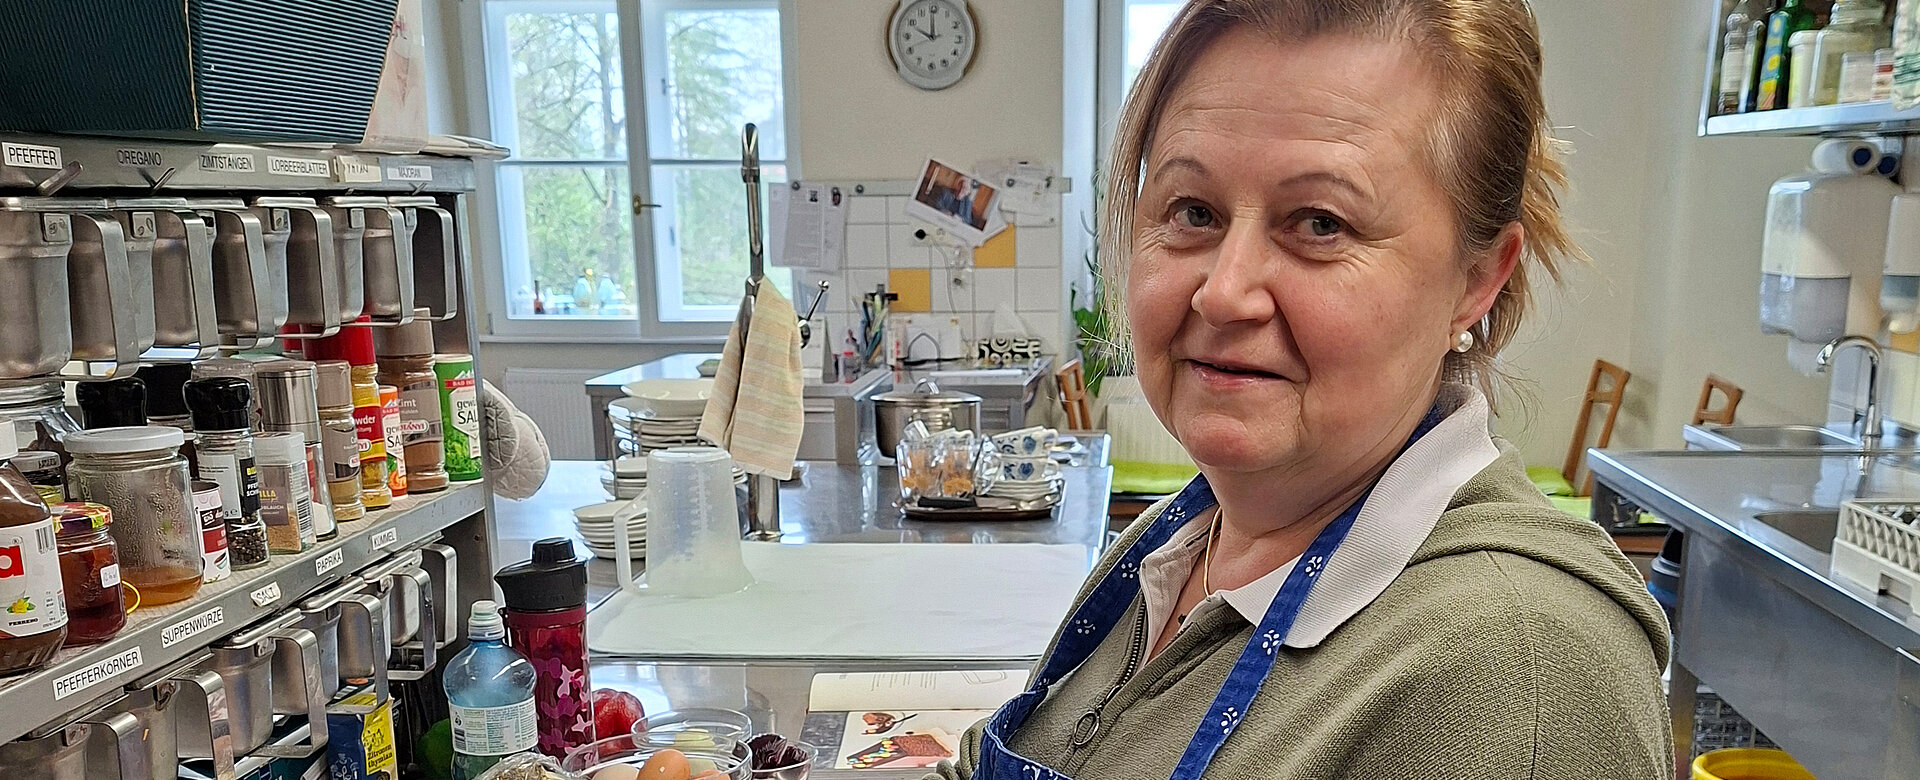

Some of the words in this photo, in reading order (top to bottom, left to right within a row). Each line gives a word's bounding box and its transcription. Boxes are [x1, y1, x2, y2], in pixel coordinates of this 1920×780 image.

[8, 146, 58, 166] PFEFFER
[117, 149, 162, 166] OREGANO
[201, 154, 253, 170] ZIMTSTANGEN
[355, 414, 376, 425] wder
[457, 410, 479, 425] SAL
[316, 551, 342, 573] PAPRIKA
[8, 617, 39, 627] FERRERO
